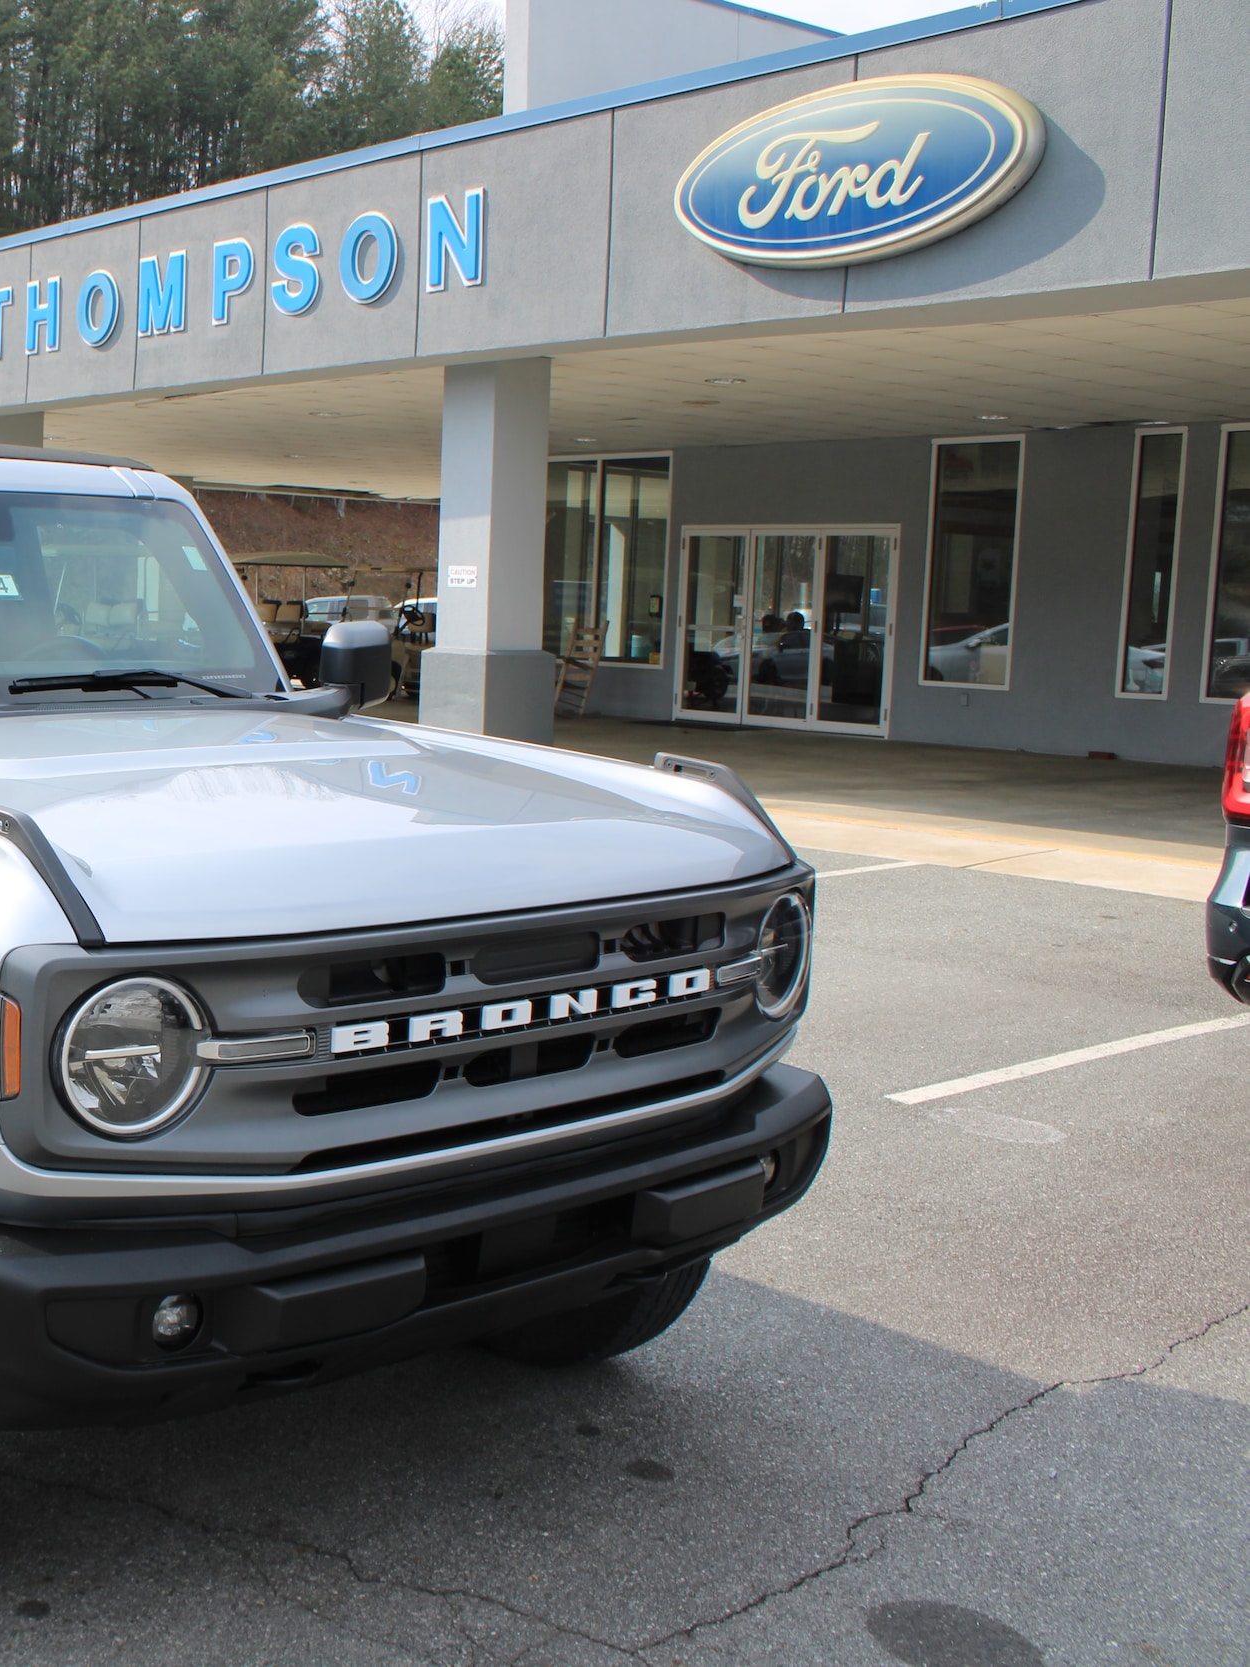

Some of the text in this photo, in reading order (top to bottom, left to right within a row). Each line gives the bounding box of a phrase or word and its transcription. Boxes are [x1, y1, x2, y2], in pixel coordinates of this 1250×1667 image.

[738, 121, 932, 230] Ford
[450, 568, 476, 576] CAUTION
[330, 967, 711, 1055] BRONCO
